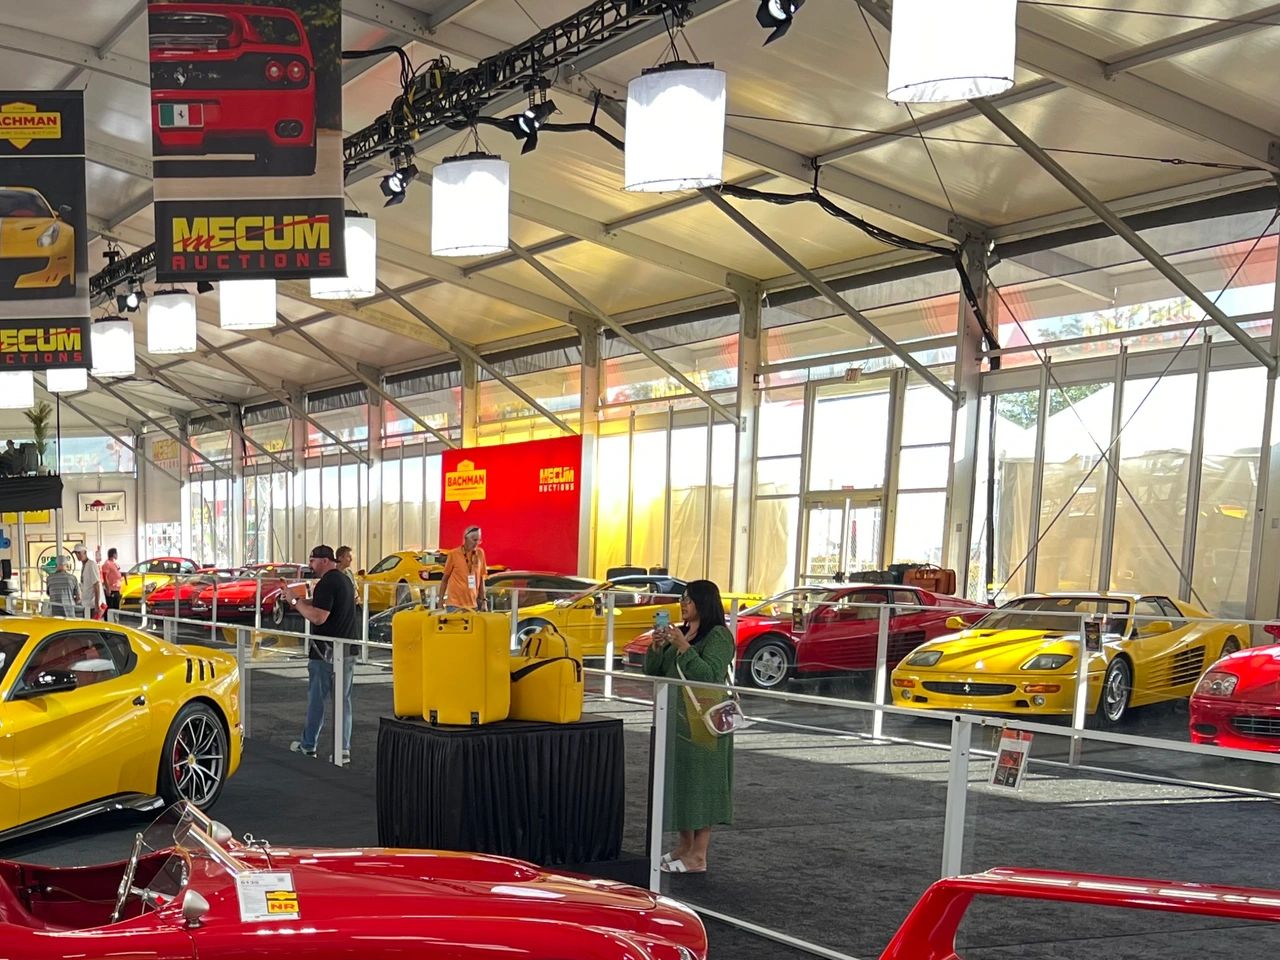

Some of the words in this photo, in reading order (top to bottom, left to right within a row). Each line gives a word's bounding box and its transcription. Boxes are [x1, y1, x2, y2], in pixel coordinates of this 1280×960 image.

[172, 215, 330, 253] MECUM
[172, 252, 332, 271] AUCTIONS
[447, 474, 484, 487] BACHMAN
[539, 467, 575, 484] MECUM
